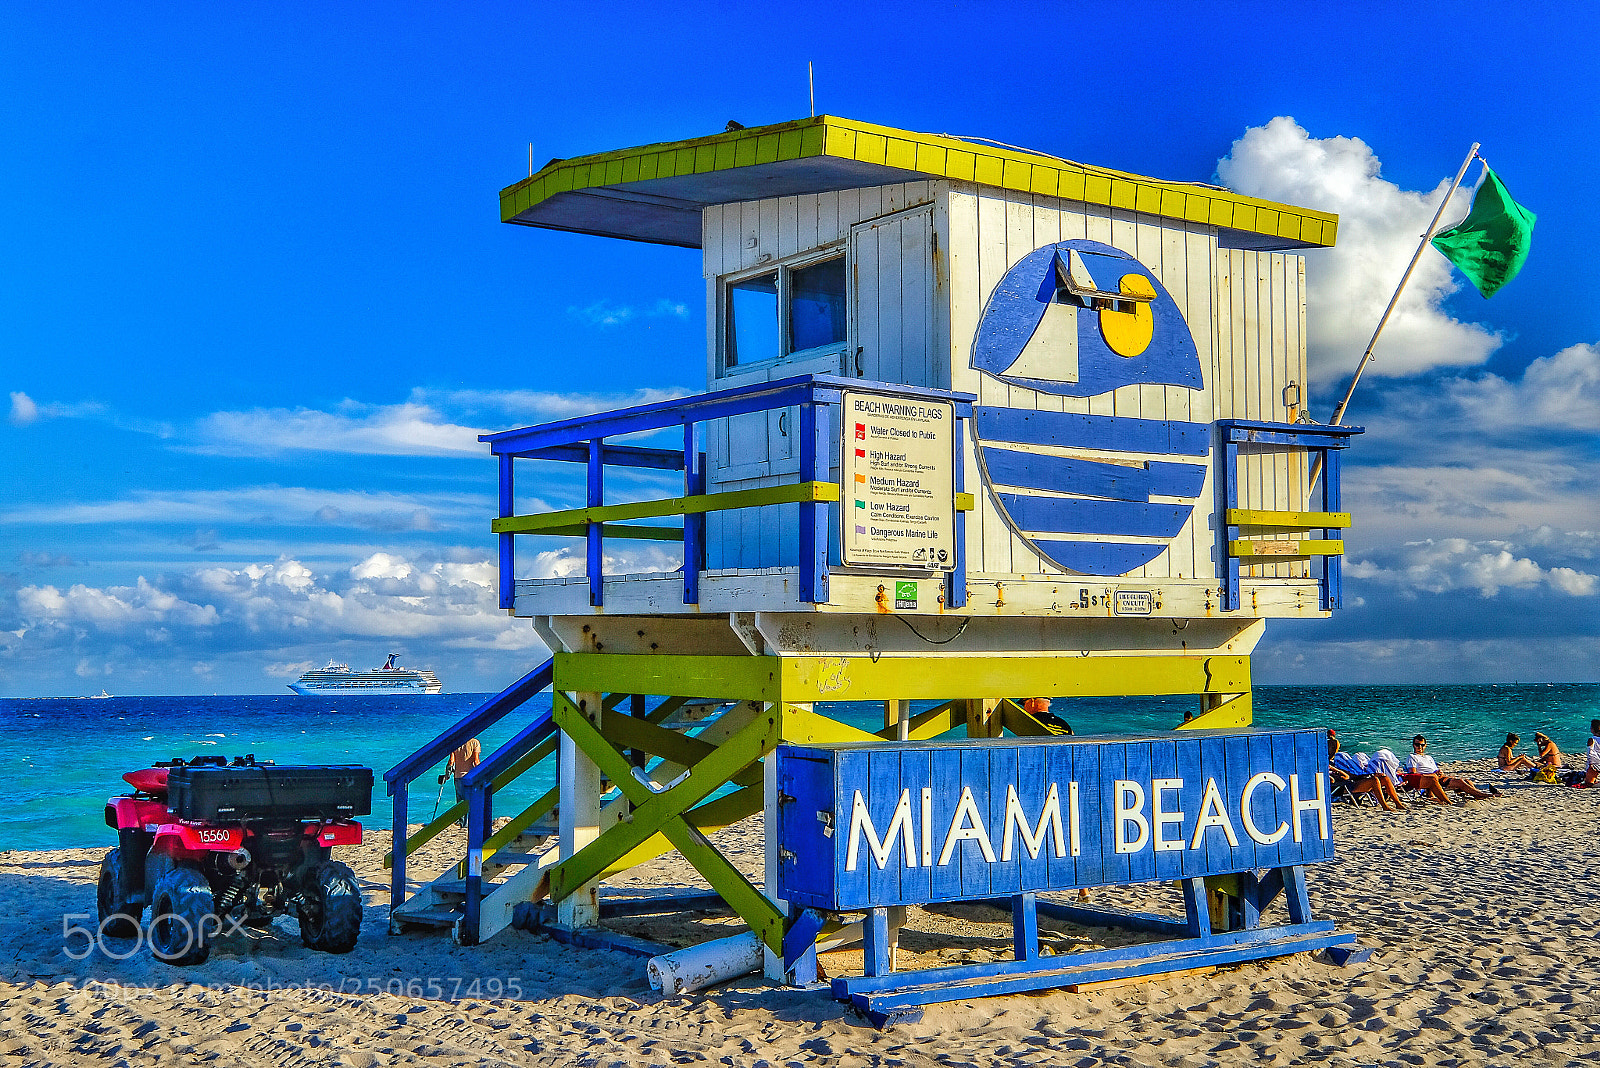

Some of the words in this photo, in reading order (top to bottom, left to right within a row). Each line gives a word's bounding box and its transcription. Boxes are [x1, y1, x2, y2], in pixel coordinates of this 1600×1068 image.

[854, 400, 881, 413] BEACH
[882, 403, 917, 417] WARNING
[918, 407, 942, 420] FLAGS
[870, 426, 889, 436] Water
[889, 427, 911, 438] Closed
[911, 430, 917, 438] to
[870, 450, 884, 461] High
[884, 451, 907, 461] Hazard
[870, 476, 895, 486] Medium
[896, 477, 920, 488] Hazard
[870, 501, 884, 511] Low
[886, 502, 910, 512] Hazard
[870, 526, 904, 538] Dangerous
[905, 528, 926, 538] Marine
[927, 530, 938, 539] Life
[846, 781, 1081, 872] MIAMI
[1114, 771, 1330, 855] BEACH
[198, 829, 230, 843] 15560
